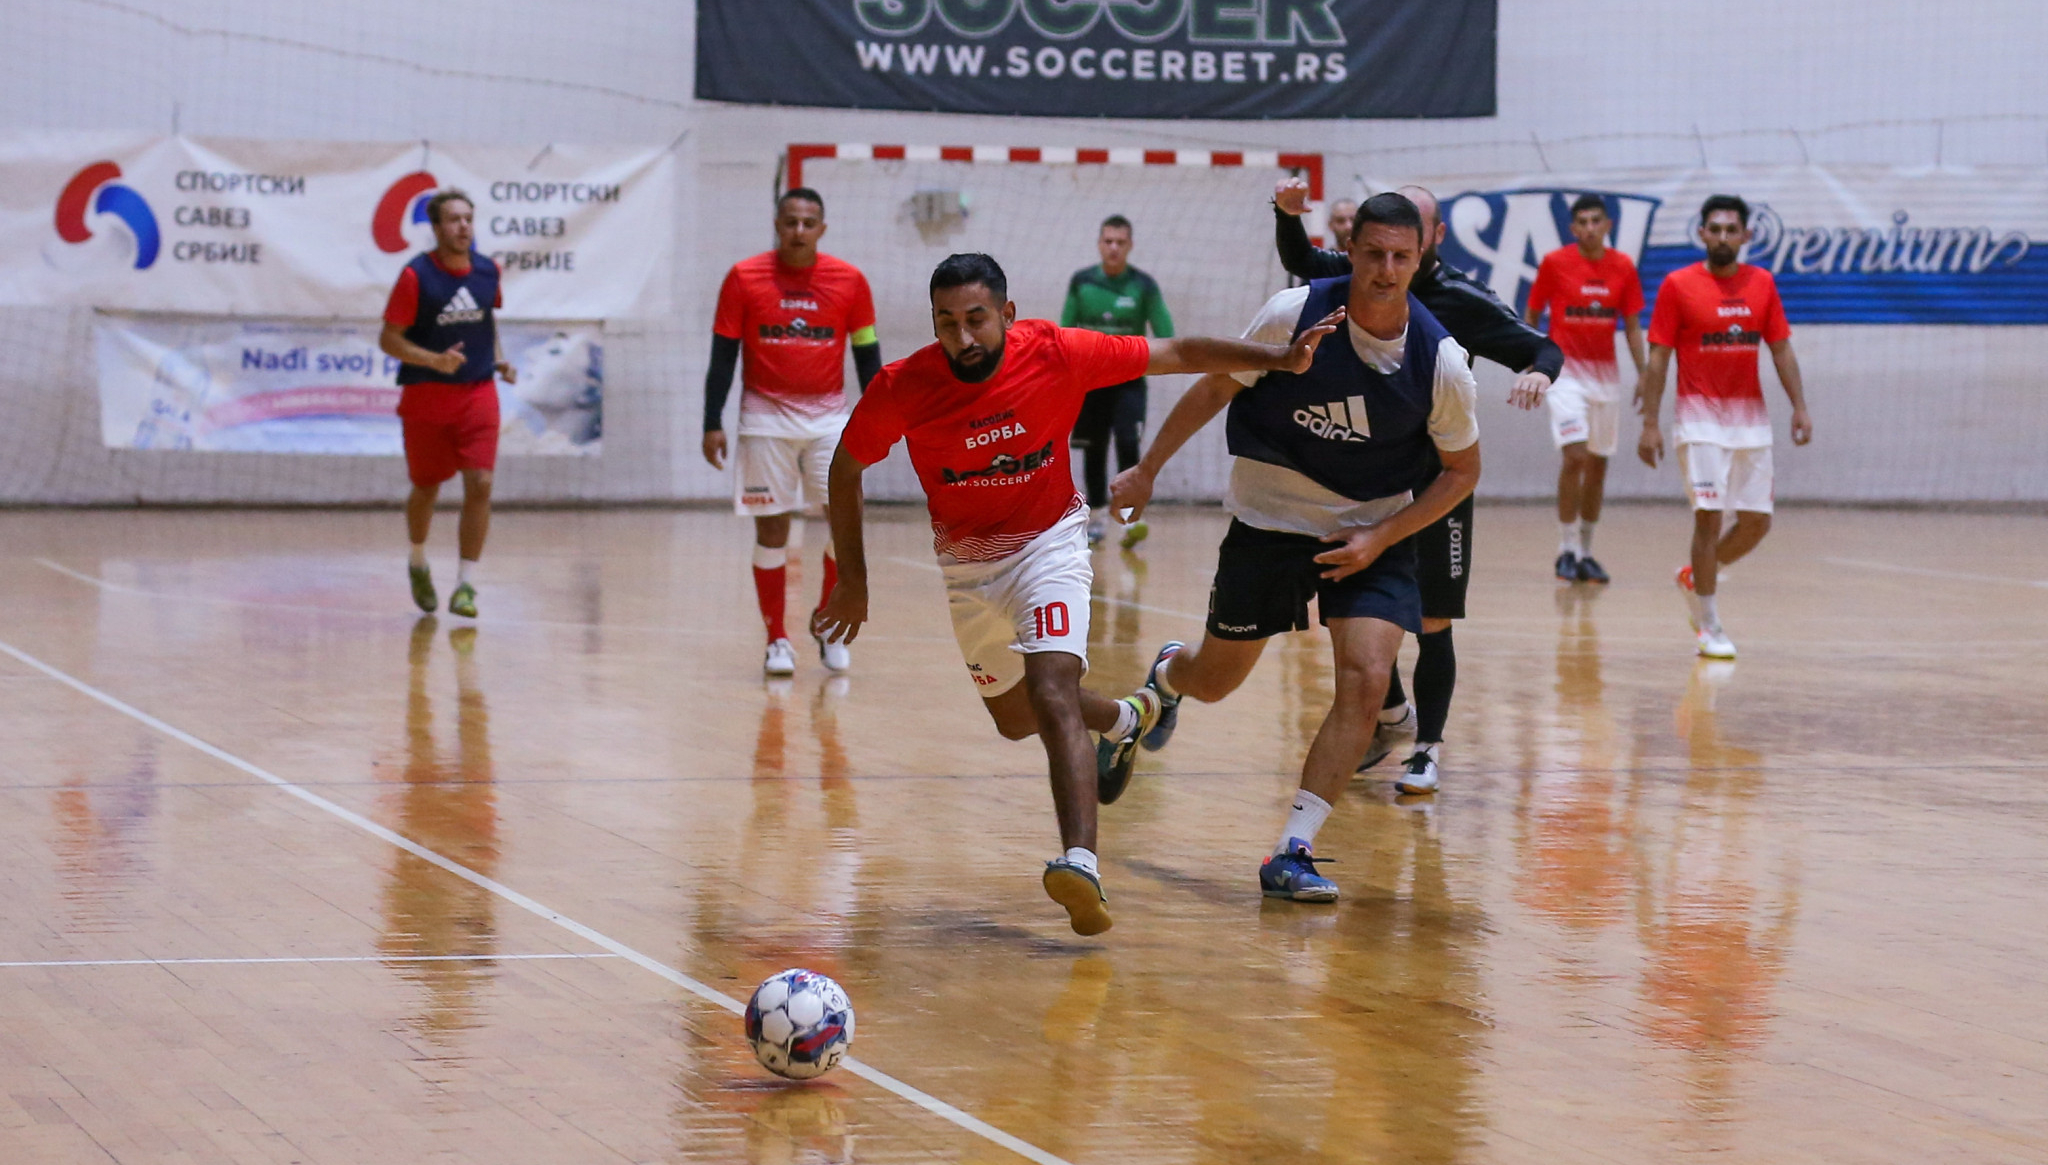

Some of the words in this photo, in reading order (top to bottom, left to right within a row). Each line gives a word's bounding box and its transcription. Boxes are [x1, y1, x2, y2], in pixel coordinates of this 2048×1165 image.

[855, 40, 1348, 83] WWW.SOCCERBET.RS
[175, 170, 304, 195] СПОРТСКИ
[490, 181, 620, 203] СПОРТСКИ
[174, 205, 251, 229] САВЕЗ
[490, 216, 566, 238] САВЕЗ
[173, 241, 263, 264] СРБИЈЕ
[316, 348, 374, 377] svoj
[965, 422, 1027, 450] БОРБА
[1447, 517, 1463, 579] Joma
[1033, 601, 1070, 640] 10
